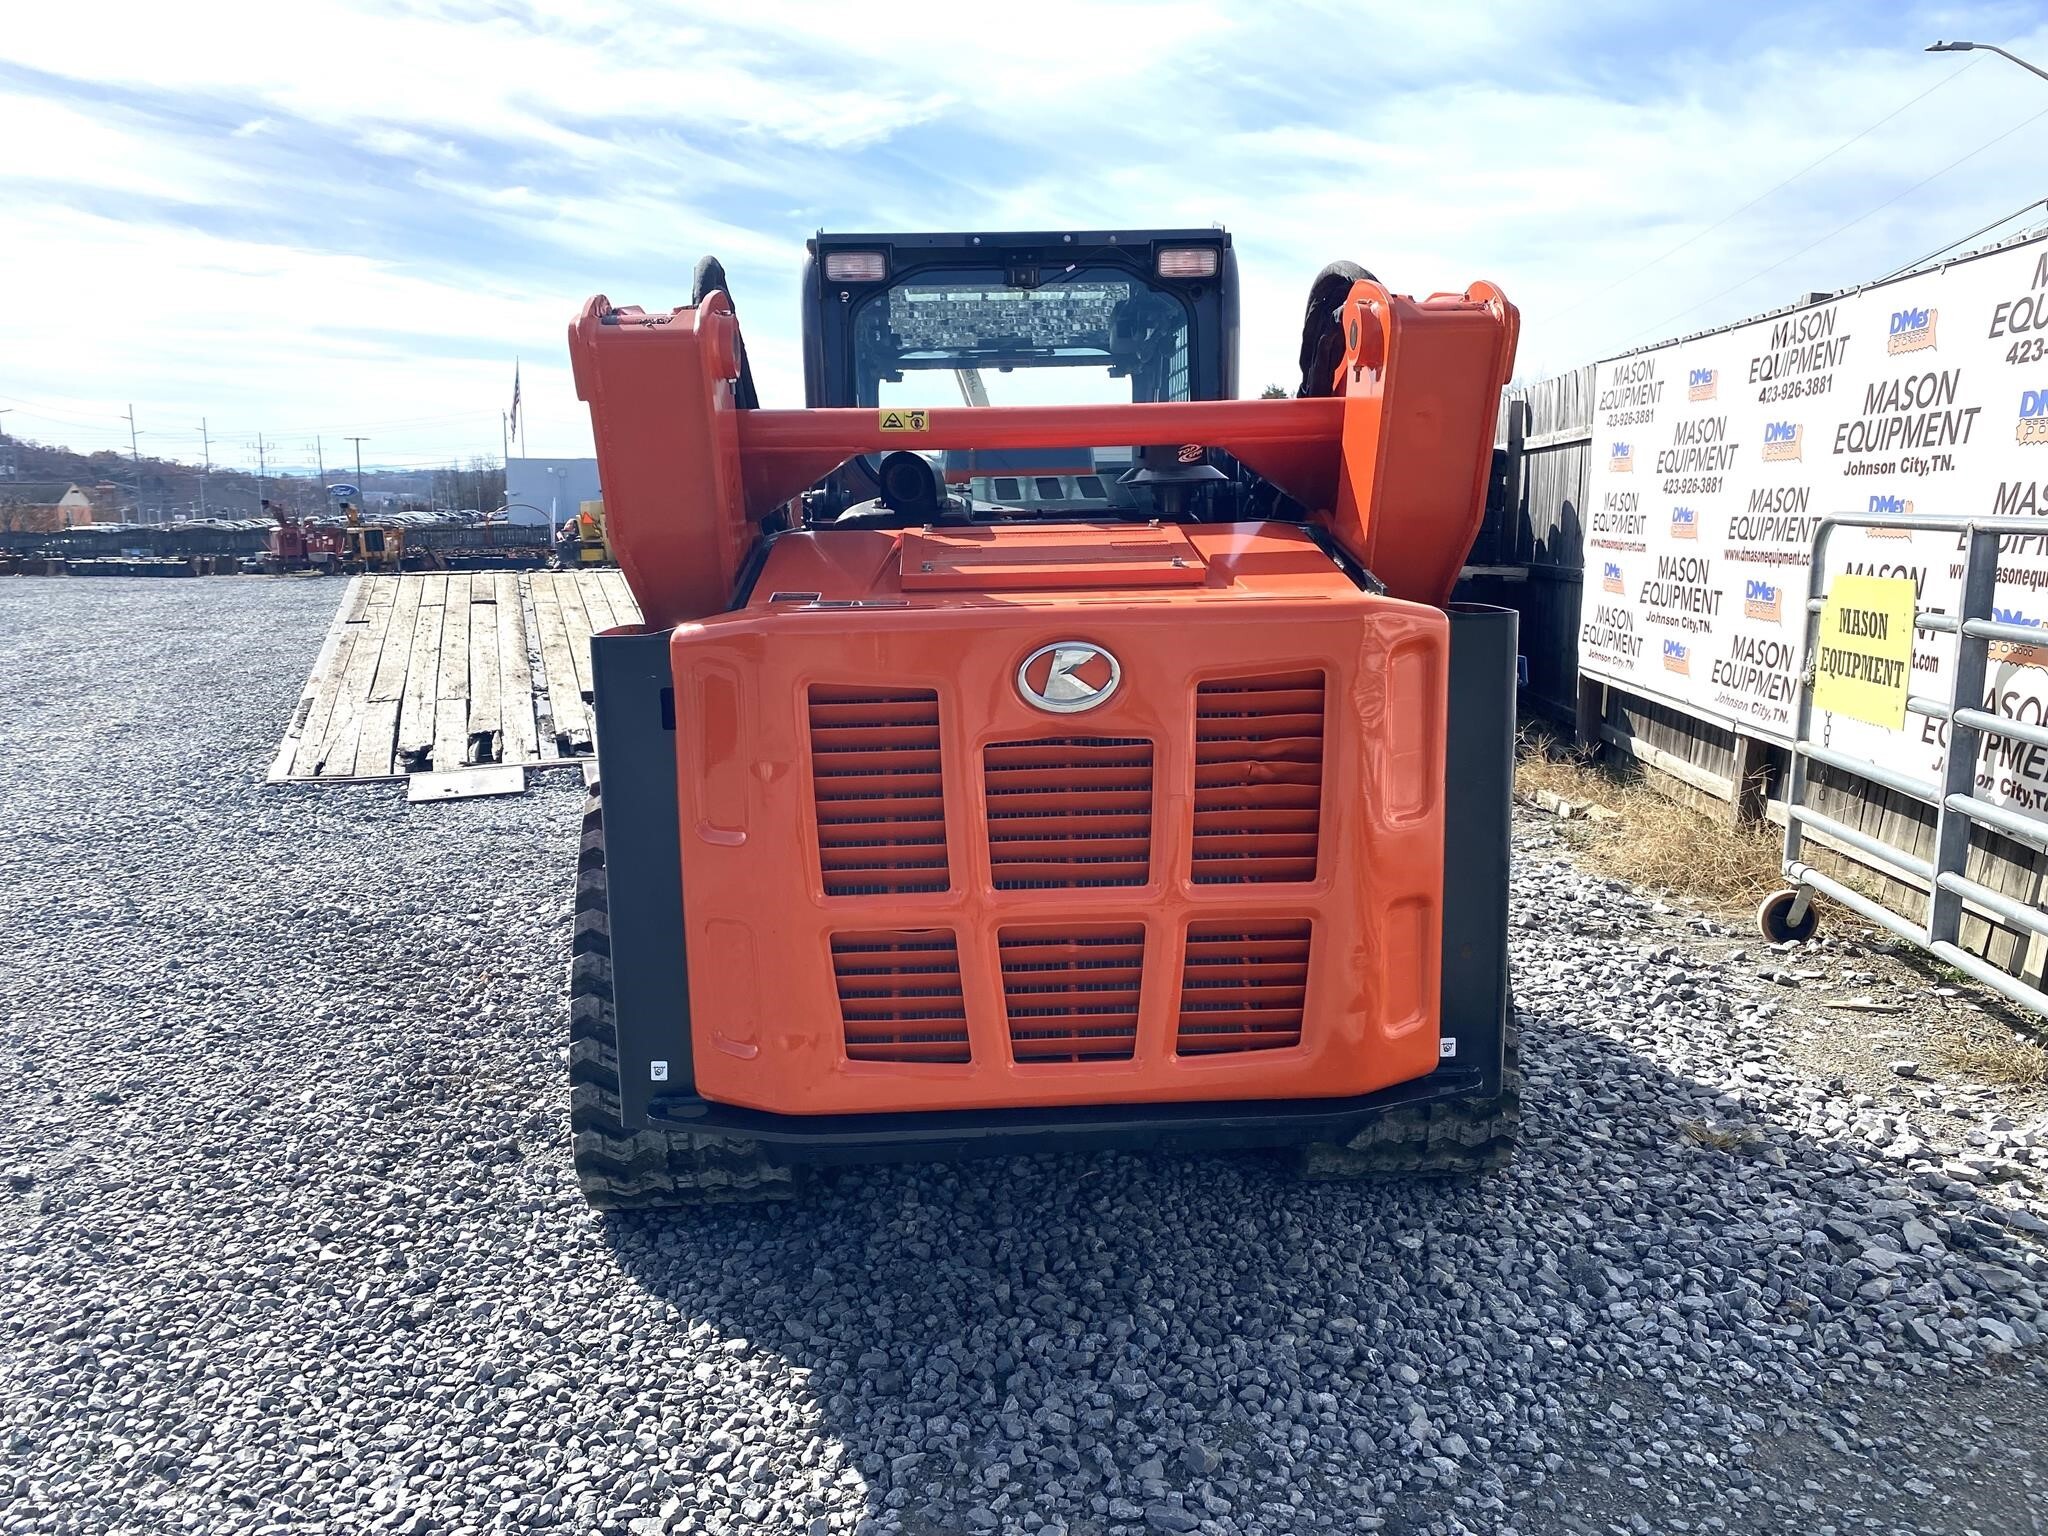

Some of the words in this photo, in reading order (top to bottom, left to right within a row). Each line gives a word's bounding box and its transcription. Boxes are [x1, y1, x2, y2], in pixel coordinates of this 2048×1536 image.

[1771, 306, 1837, 350] MASON
[1613, 358, 1655, 386] MASON
[1749, 335, 1851, 384] EQUIPMENT
[1599, 380, 1664, 411] EQUIPMENT
[1758, 374, 1833, 404] 423-926-3881
[1863, 368, 1961, 416] MASON
[1674, 416, 1727, 446] MASON
[1833, 406, 1982, 455] EQUIPMENT
[1656, 444, 1738, 474] EQUIPMENT
[1844, 460, 1896, 477] Johnson
[1662, 476, 1723, 494] 423-926-3881
[1748, 487, 1810, 513] MASON
[1603, 492, 1640, 512] MASON
[1593, 513, 1647, 535] EQUIPMENT
[1728, 516, 1822, 542] EQUIPMENT
[1658, 555, 1710, 584] MASON
[1639, 581, 1723, 616] EQUIPMENT
[1595, 604, 1633, 632] MASON
[1645, 611, 1680, 628] Johnson
[1839, 607, 1888, 640] MASON
[1582, 624, 1643, 658] EQUIPMENT
[1588, 649, 1611, 663] Johnson
[1731, 634, 1794, 672] MASON
[1711, 659, 1798, 705] EQUIPMEN
[1820, 647, 1905, 689] EQUIPMENT
[1715, 691, 1748, 711] Johnson
